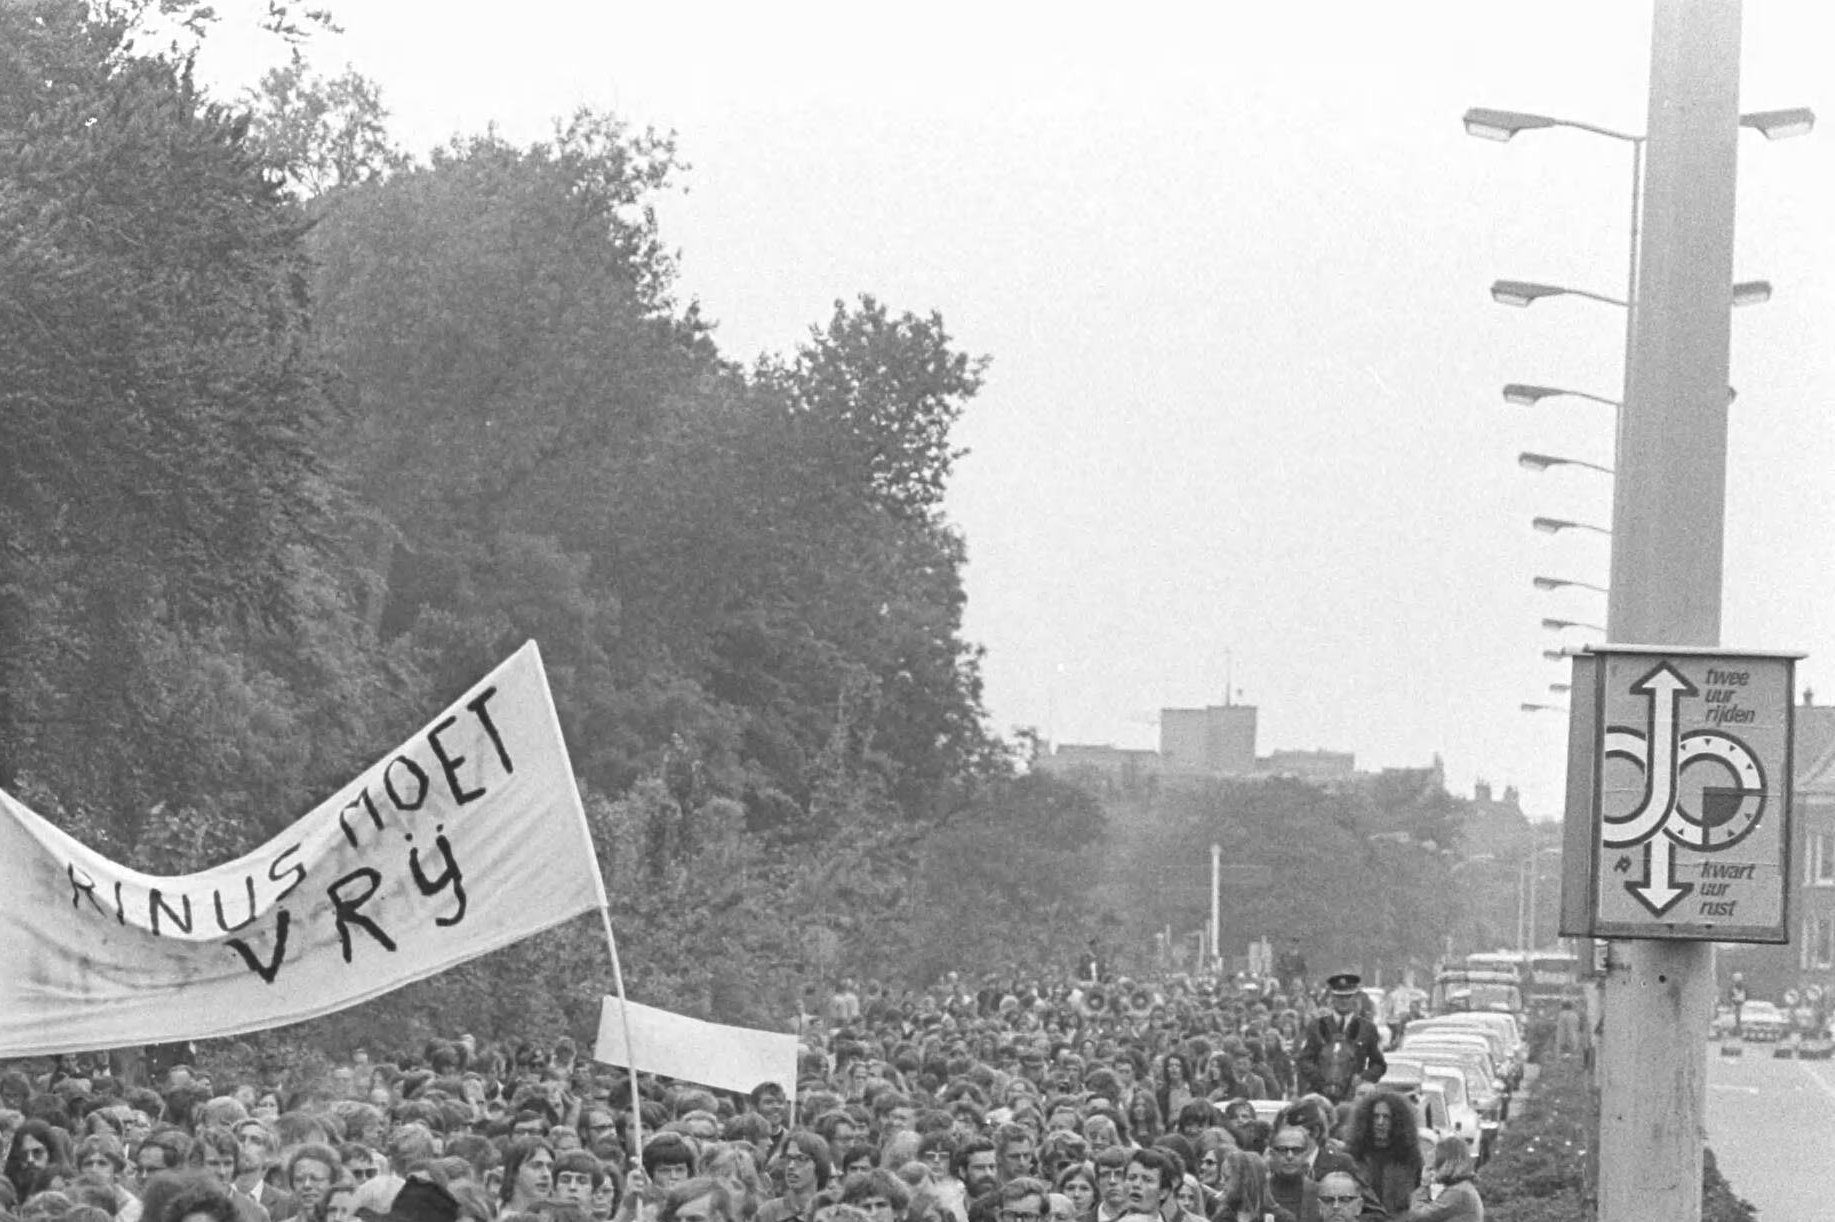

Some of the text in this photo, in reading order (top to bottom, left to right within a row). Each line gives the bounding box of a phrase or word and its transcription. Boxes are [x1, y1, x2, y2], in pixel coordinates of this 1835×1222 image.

[1705, 668, 1750, 686] twee
[1705, 689, 1735, 703] uur
[1705, 705, 1755, 727] rijden
[67, 687, 515, 935] RINUS MOET
[1701, 861, 1755, 880] kwart
[1700, 882, 1730, 895] uur
[1699, 900, 1737, 916] rust
